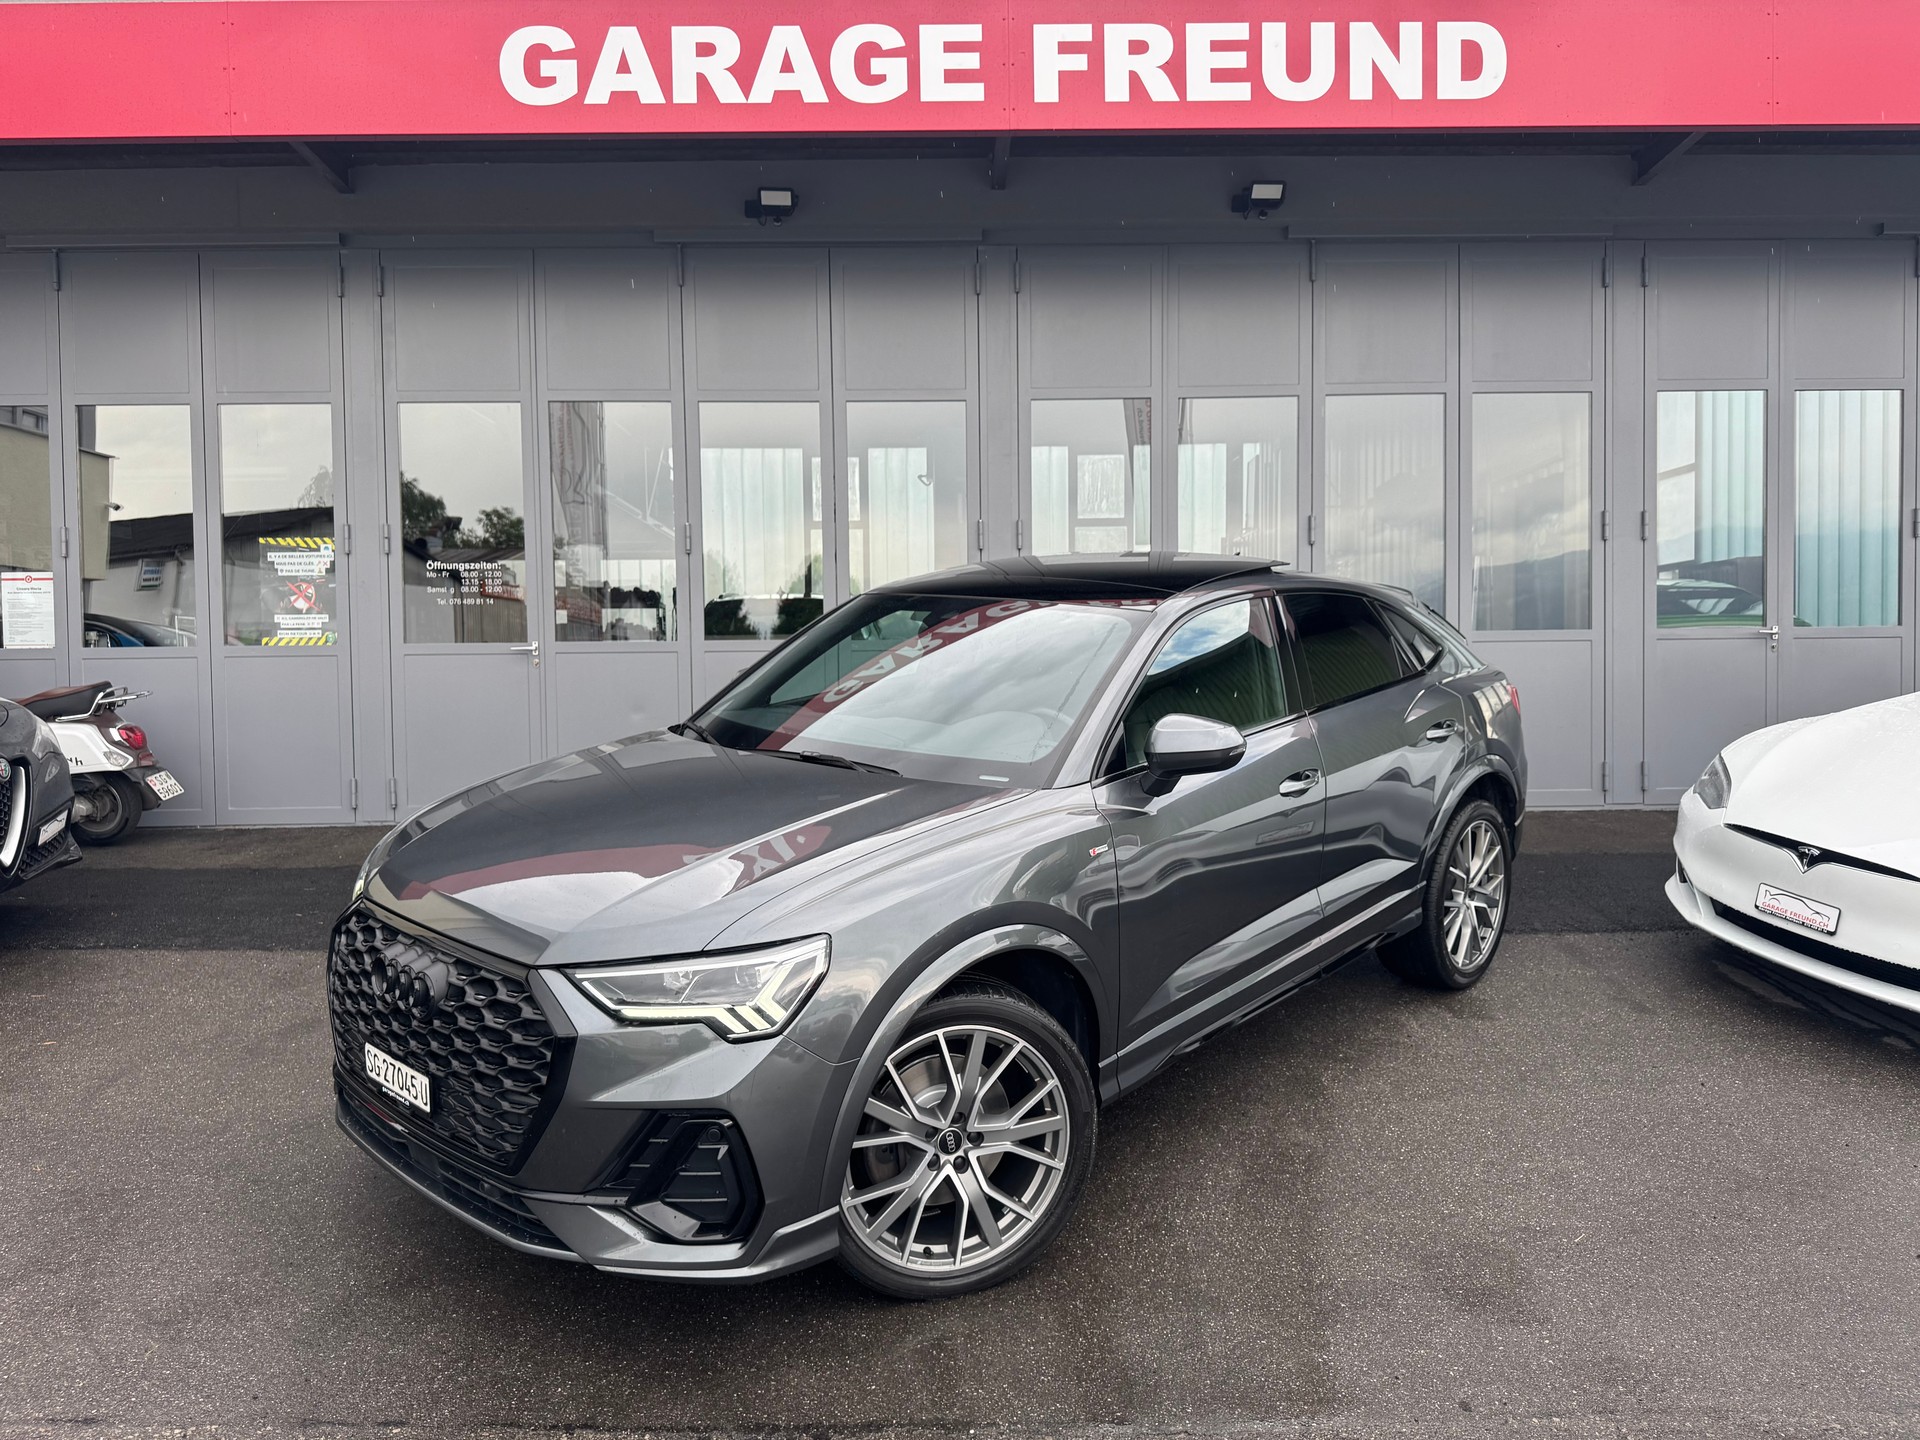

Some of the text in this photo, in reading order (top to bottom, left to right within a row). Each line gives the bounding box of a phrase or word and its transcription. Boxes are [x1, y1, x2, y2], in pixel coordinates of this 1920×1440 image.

[499, 21, 1508, 106] GARAGE FREUND
[426, 560, 502, 571] Öffnungszeiten:
[427, 586, 455, 594] Samstg
[155, 773, 168, 786] SG
[1761, 901, 1829, 928] GARAGE FREUND.CH
